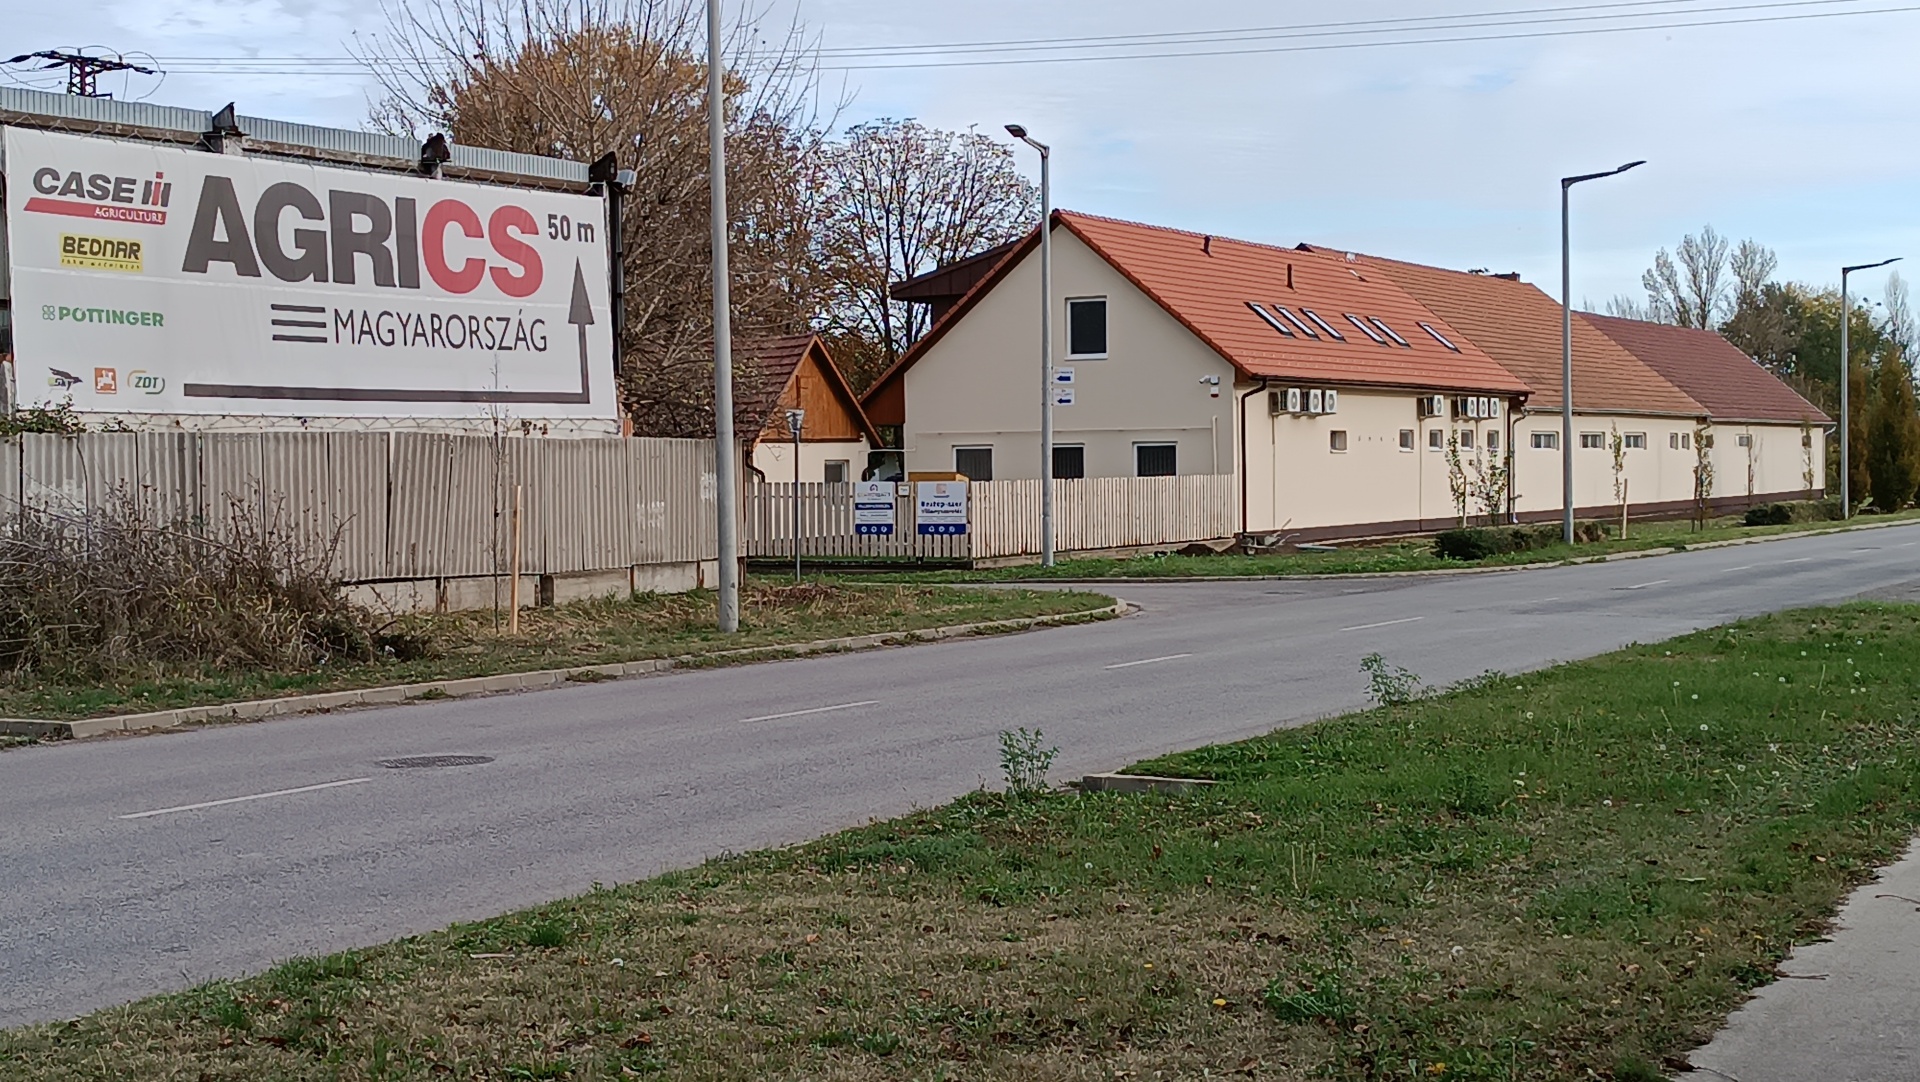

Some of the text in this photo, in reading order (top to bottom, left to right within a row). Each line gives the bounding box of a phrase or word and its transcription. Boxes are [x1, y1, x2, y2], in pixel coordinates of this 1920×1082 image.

[33, 167, 137, 204] CASE
[94, 207, 163, 223] AGRICULTURE
[547, 213, 595, 243] 50 m
[62, 236, 141, 260] BEDNAR
[181, 174, 544, 297] AGRICS
[334, 309, 548, 352] MAGYARORSZÁG
[135, 376, 159, 389] ZDT
